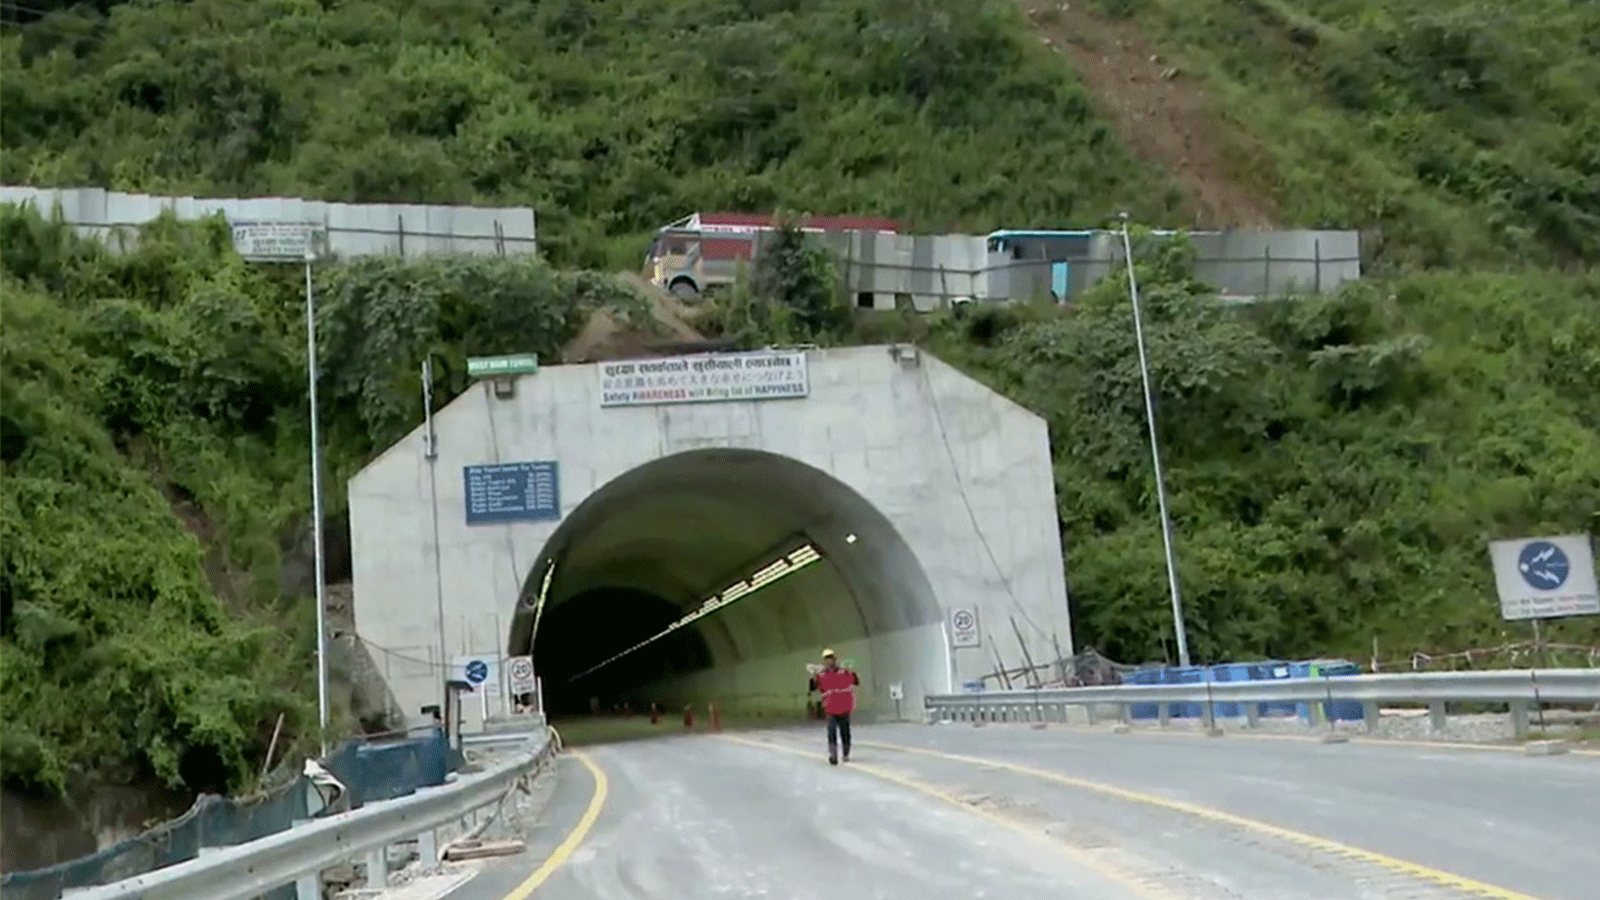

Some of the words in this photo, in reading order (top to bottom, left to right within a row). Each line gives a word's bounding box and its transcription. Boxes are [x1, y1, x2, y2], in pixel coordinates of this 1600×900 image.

[603, 391, 630, 402] Safety
[632, 388, 686, 400] AWARENESS
[707, 385, 729, 398] Bring
[755, 382, 804, 394] HAPPINESS
[958, 615, 970, 625] 20
[515, 664, 527, 674] 20
